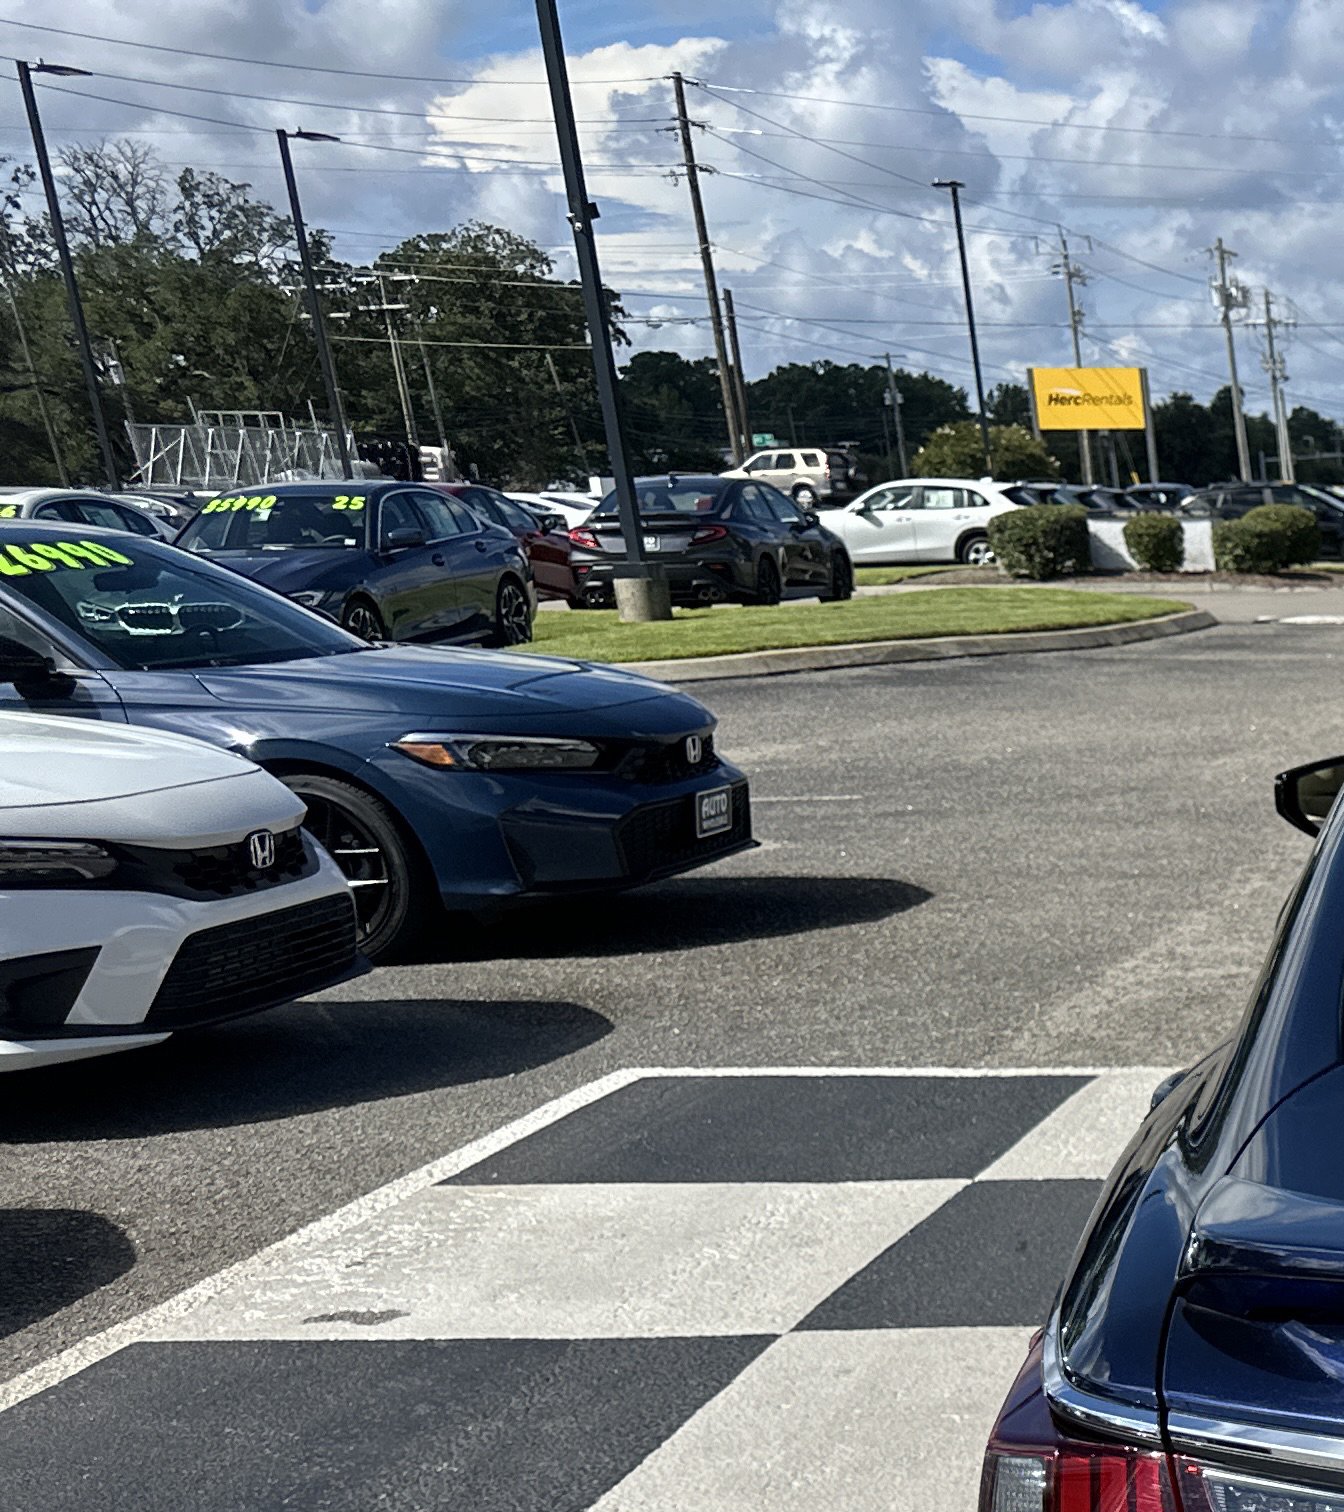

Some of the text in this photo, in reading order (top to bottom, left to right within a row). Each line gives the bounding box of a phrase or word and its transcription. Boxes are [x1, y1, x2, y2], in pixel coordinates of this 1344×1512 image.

[1048, 392, 1133, 406] HercRentals
[332, 495, 366, 510] 25
[702, 793, 728, 819] AUTO
